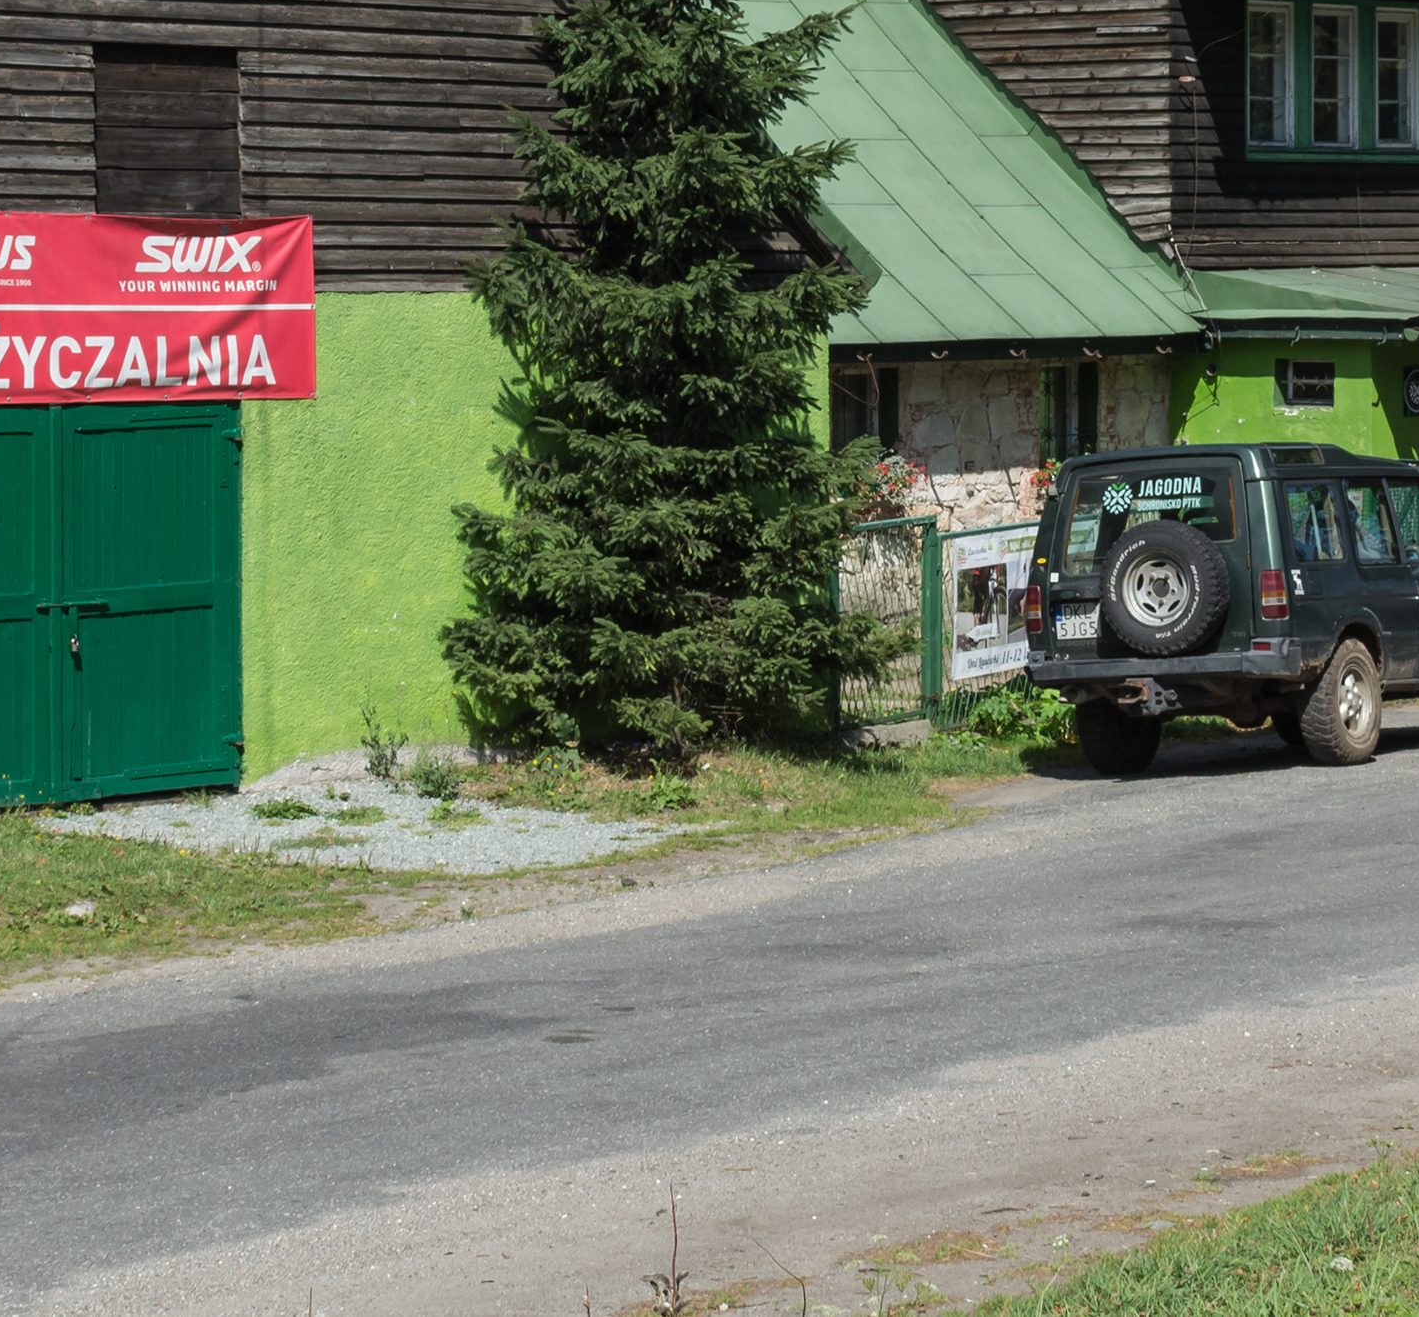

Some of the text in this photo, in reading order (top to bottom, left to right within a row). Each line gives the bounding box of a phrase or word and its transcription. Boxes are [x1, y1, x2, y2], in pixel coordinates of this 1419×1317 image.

[135, 236, 261, 272] SWIX
[119, 279, 277, 292] YOUR WINNING MARGIN
[1138, 477, 1202, 497] JAGODNA
[1137, 497, 1201, 512] SCHRONISKO PTTK
[1063, 605, 1092, 621] DKL
[1060, 621, 1097, 637] 5JG5
